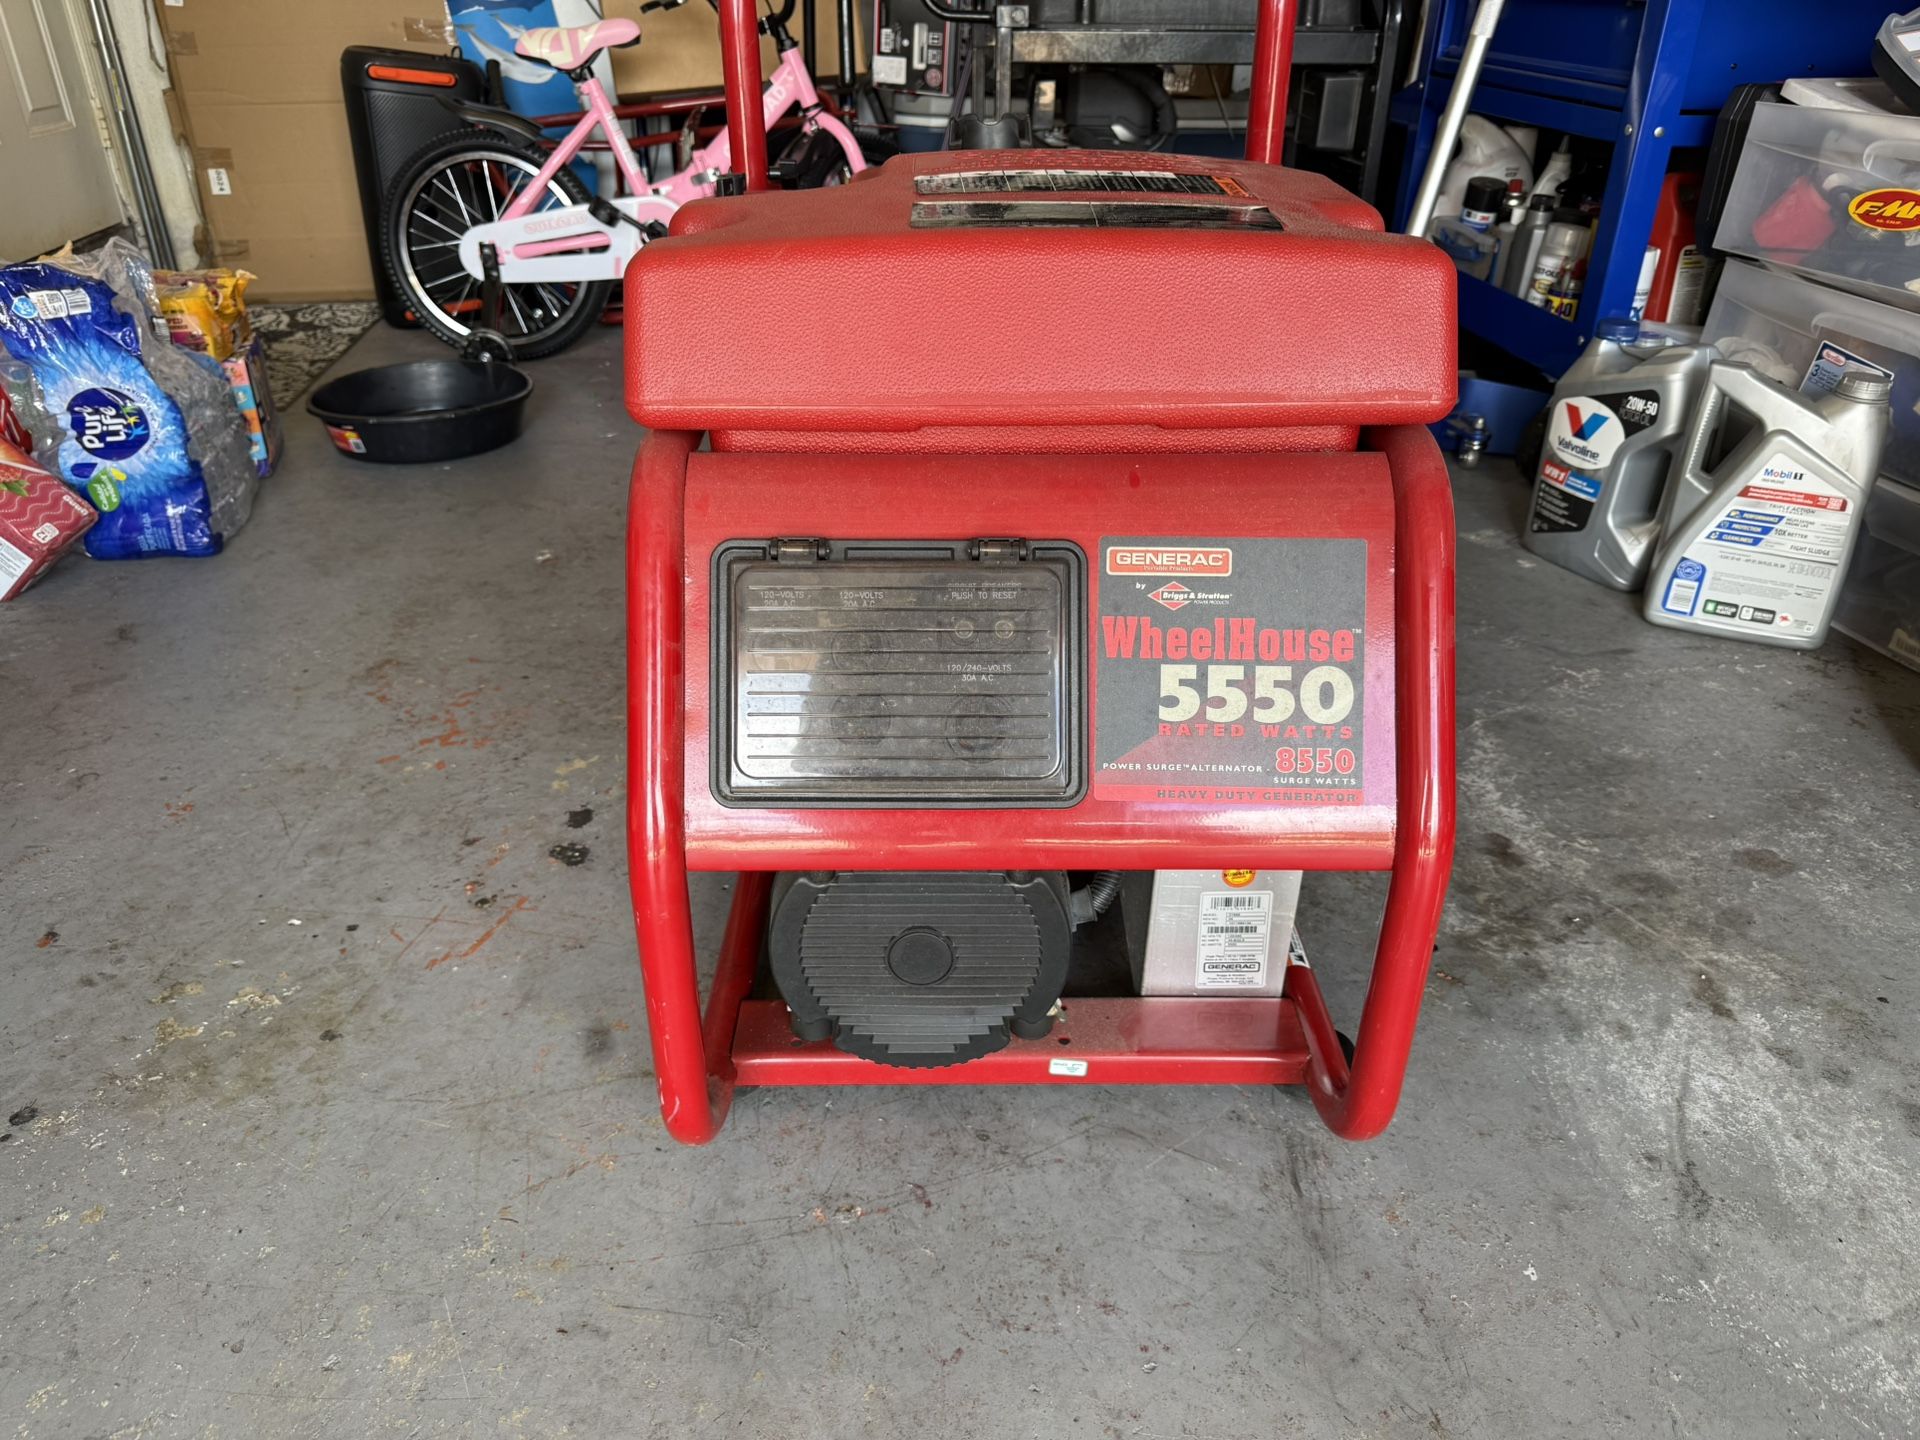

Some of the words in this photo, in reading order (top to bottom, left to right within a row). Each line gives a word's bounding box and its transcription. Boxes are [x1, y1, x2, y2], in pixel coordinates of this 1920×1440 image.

[1625, 395, 1659, 416] 20W-50
[73, 405, 105, 449] Pure
[100, 405, 127, 442] Life
[1557, 435, 1600, 461] Valvoline
[1763, 468, 1793, 480] Mobil
[1793, 472, 1804, 481] 1
[1116, 552, 1224, 566] GENERAC
[1135, 582, 1146, 590] by
[760, 591, 804, 599] 120-VOLTS
[840, 591, 883, 599] 120-VOLTS
[951, 591, 973, 600] PUSH
[978, 591, 988, 600] TO
[992, 591, 1017, 600] RESET
[1162, 591, 1188, 600] Briggs
[1197, 592, 1229, 600] Stratton
[763, 600, 779, 608] 20A
[843, 600, 859, 608] 20A
[947, 664, 1012, 673] 120/240-VOLTS
[961, 674, 977, 682] 30A
[1158, 664, 1355, 725] 5550
[1158, 723, 1246, 738] RATED
[1260, 725, 1354, 739] WATTS
[1275, 747, 1356, 775] 8550
[1102, 762, 1142, 771] POWER
[1191, 763, 1263, 773] ALTERNATOR
[1273, 776, 1310, 785] SURGE
[1315, 777, 1356, 786] WATTS
[1157, 789, 1210, 800] HEAVY
[1214, 790, 1259, 801] DUTY
[1263, 791, 1358, 802] GENERATOR
